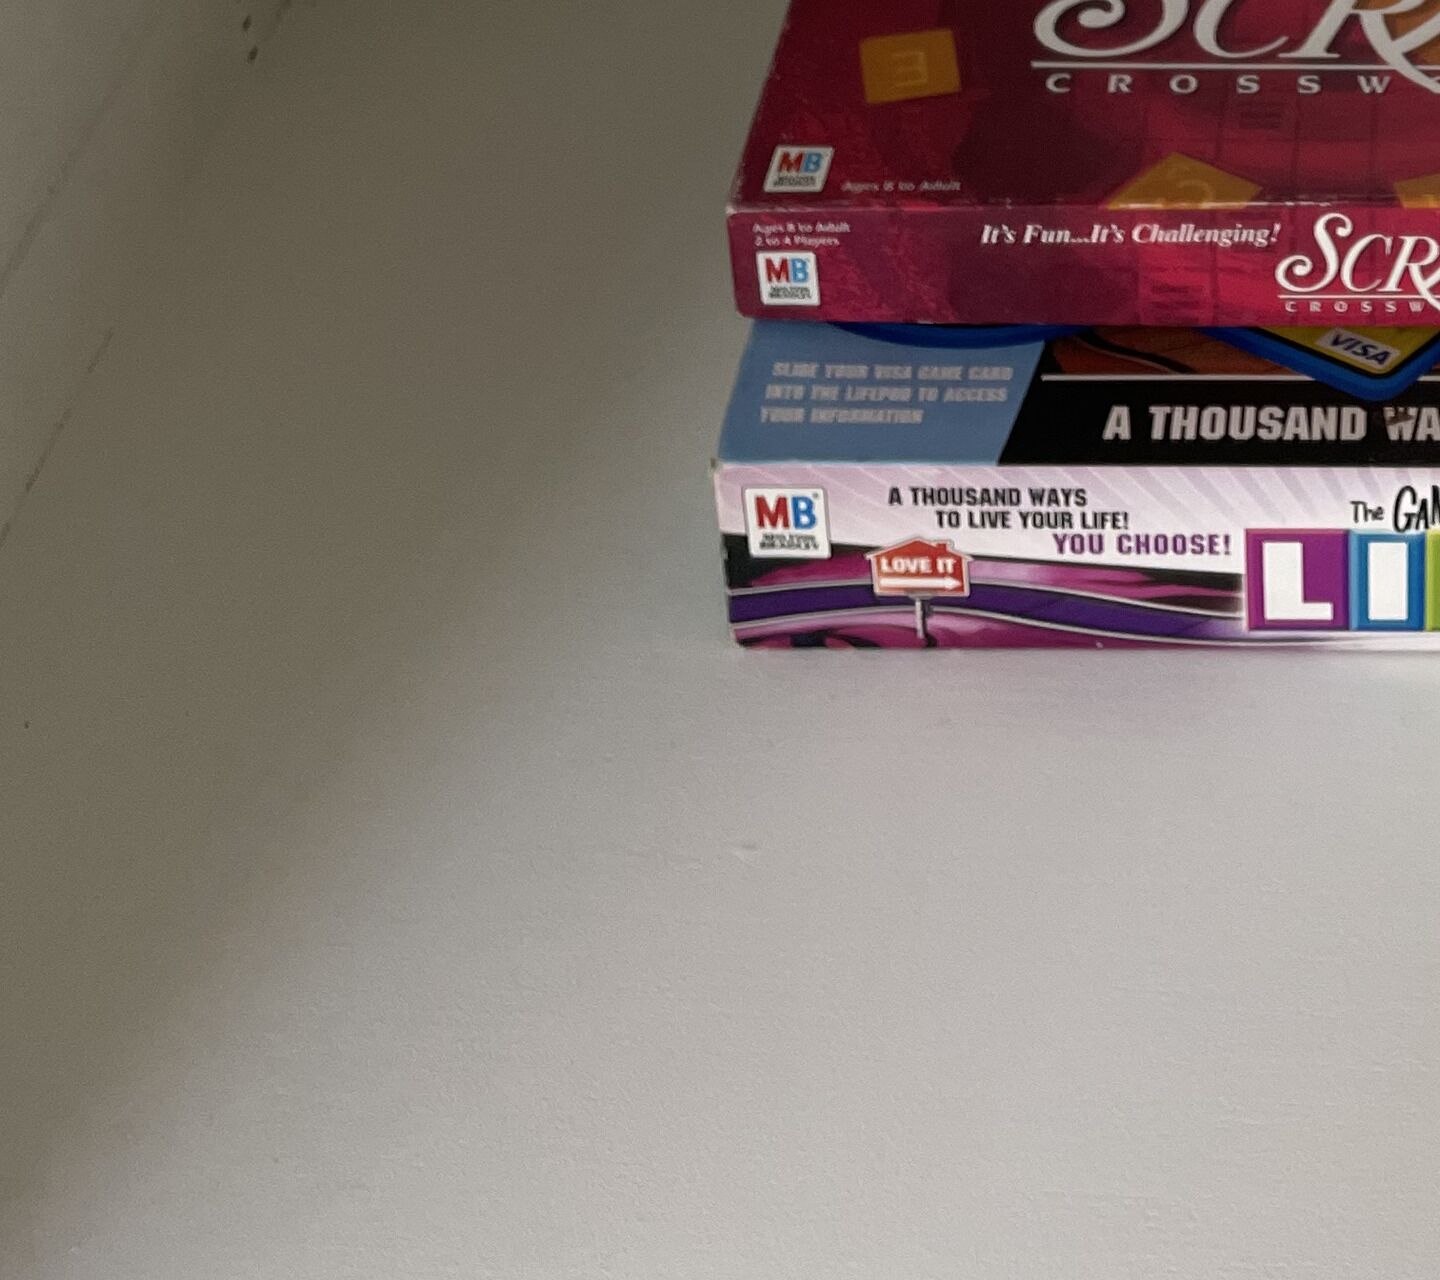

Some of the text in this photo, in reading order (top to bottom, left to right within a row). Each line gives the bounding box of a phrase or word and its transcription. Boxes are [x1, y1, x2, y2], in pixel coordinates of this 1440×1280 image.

[777, 151, 824, 173] MB
[981, 224, 1016, 244] It's
[1131, 223, 1282, 248] Challenging!
[765, 257, 809, 283] MB
[1330, 334, 1391, 365] VISA
[1102, 406, 1131, 440] A
[1149, 406, 1367, 441] THOUSAND
[888, 487, 1087, 507] A THOUSAND WAYS
[755, 495, 816, 530] MB
[936, 510, 1130, 530] TO LIVE YOUR LIFE!
[1351, 500, 1385, 523] The
[1054, 533, 1231, 555] YOU CHOOSE!
[880, 556, 957, 574] LOVE IT
